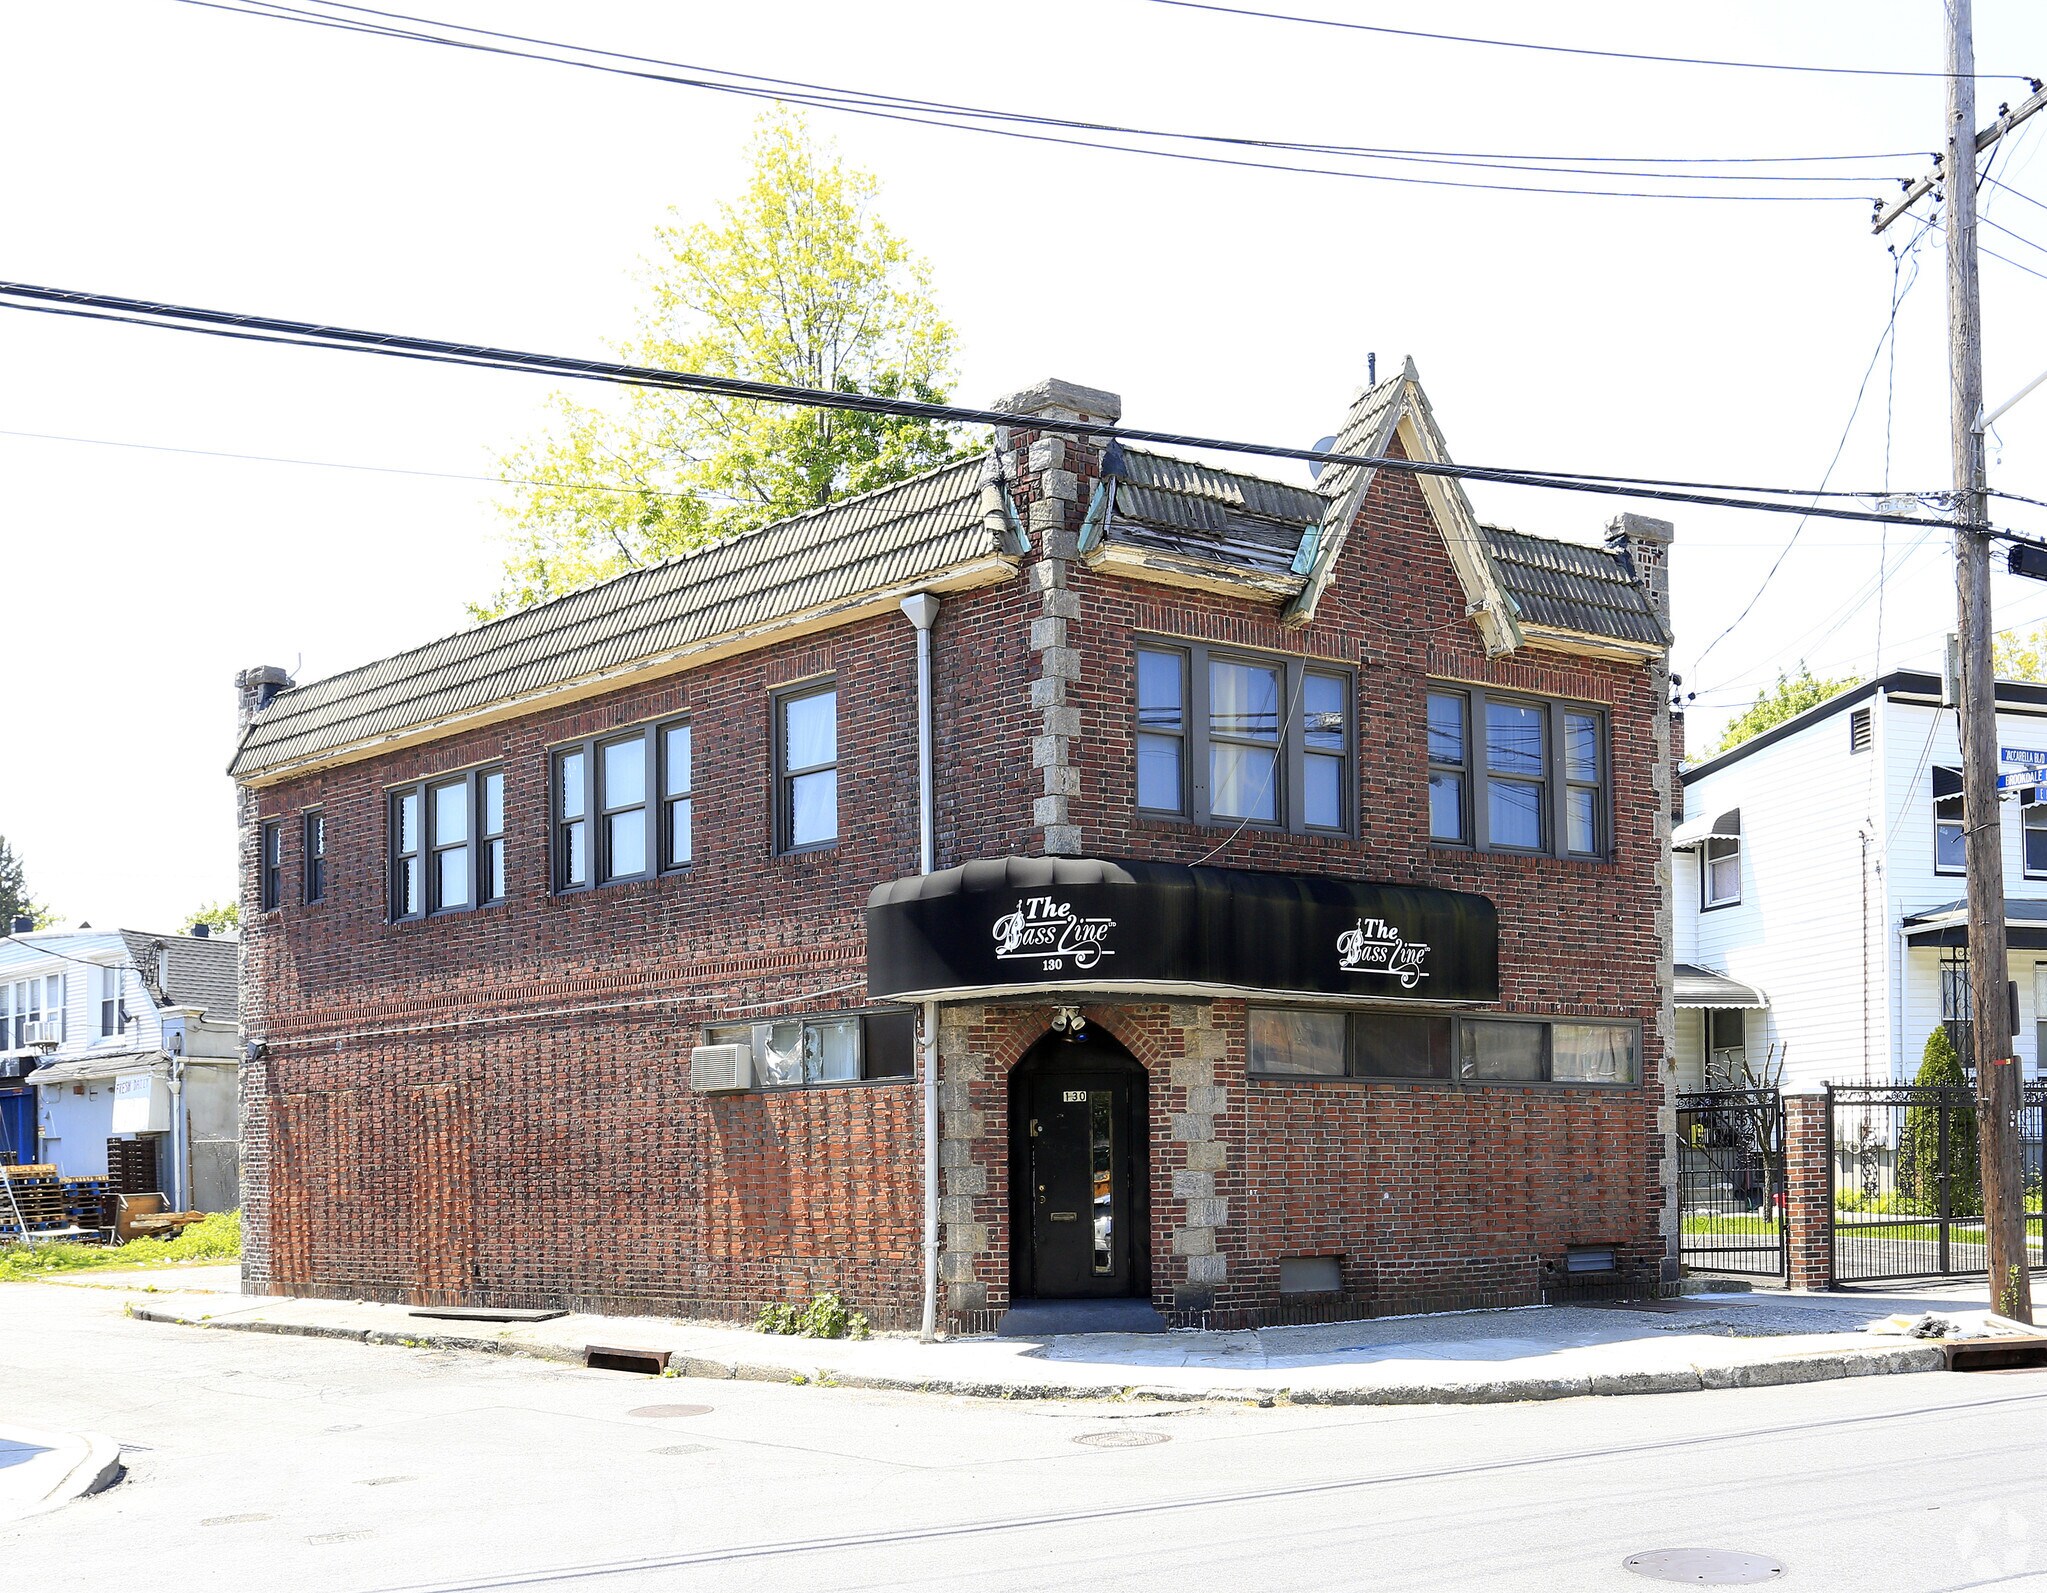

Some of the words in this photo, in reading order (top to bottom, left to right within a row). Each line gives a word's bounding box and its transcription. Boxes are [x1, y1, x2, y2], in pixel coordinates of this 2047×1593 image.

[2005, 770, 2043, 786] BROOKDALE
[1025, 896, 1071, 919] The
[992, 901, 1057, 953] Bass
[1057, 914, 1109, 969] Line
[1364, 918, 1399, 940] The
[1336, 919, 1388, 967] Bass
[1388, 938, 1425, 988] Line
[1042, 959, 1063, 971] 130
[1065, 1091, 1086, 1102] 130
